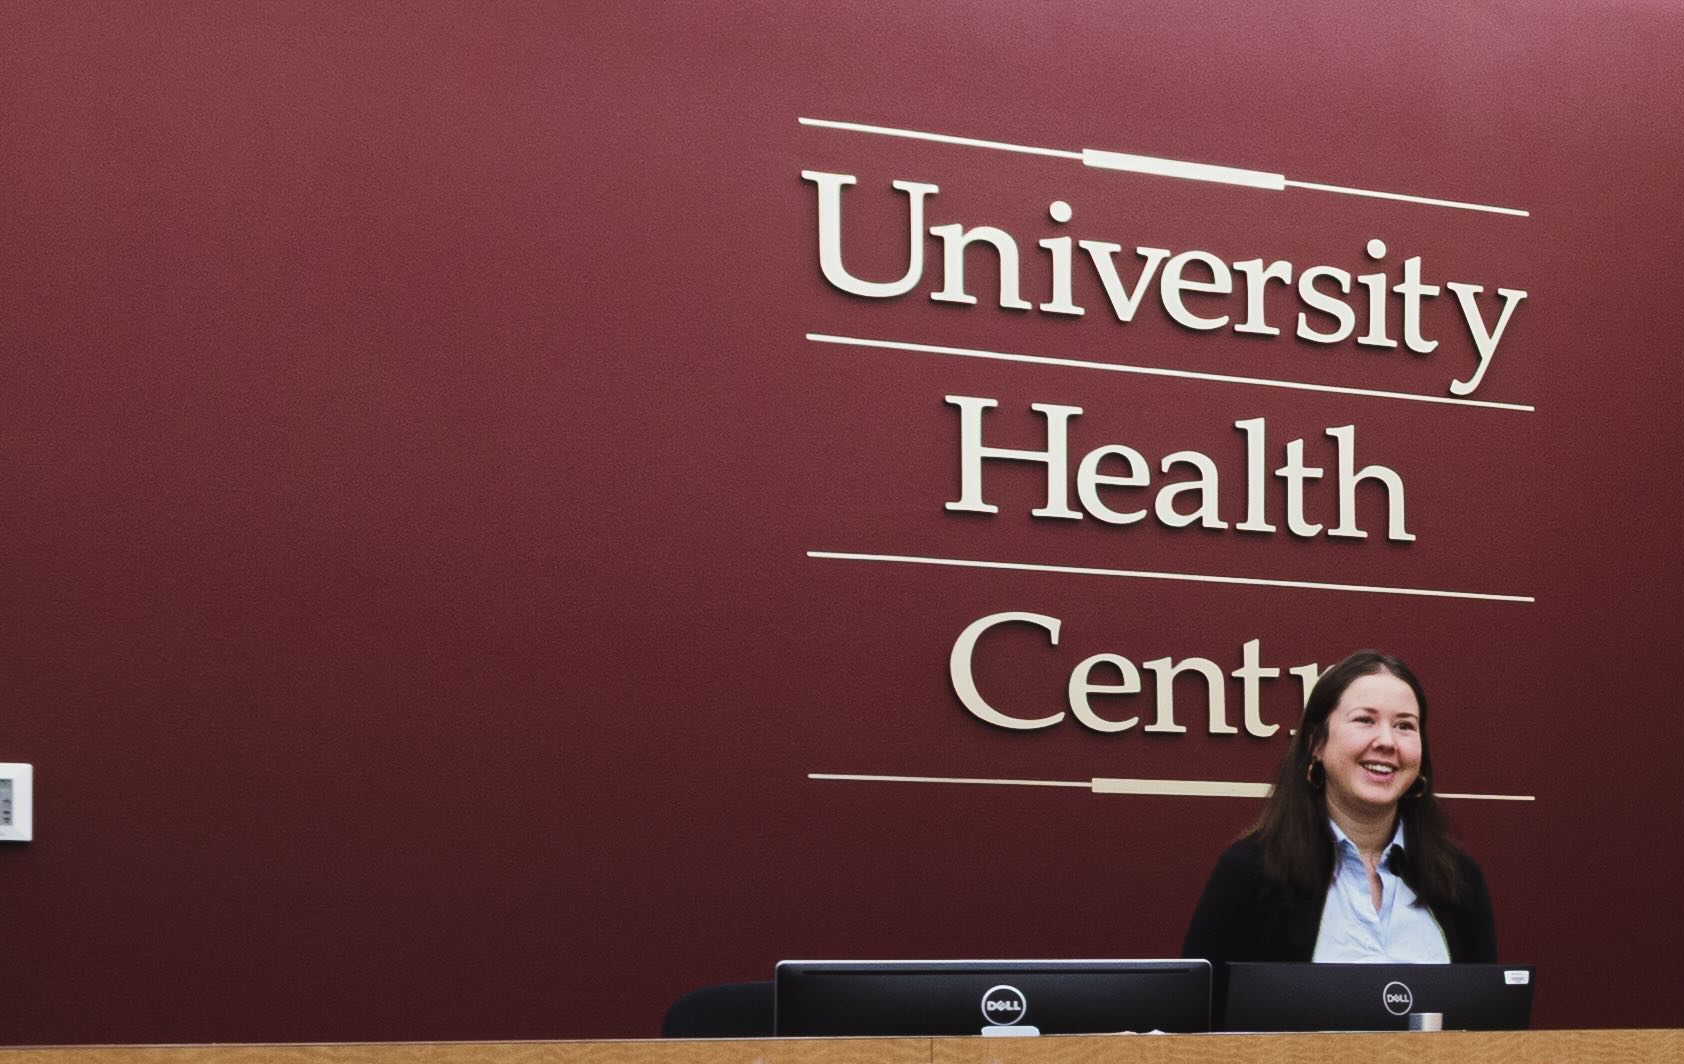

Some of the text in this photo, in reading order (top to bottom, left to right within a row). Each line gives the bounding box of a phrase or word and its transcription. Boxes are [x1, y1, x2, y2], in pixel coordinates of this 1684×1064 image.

[801, 169, 1528, 396] University
[944, 395, 1416, 542] Health
[987, 1000, 1021, 1011] DELL
[1387, 994, 1409, 1003] DELL
